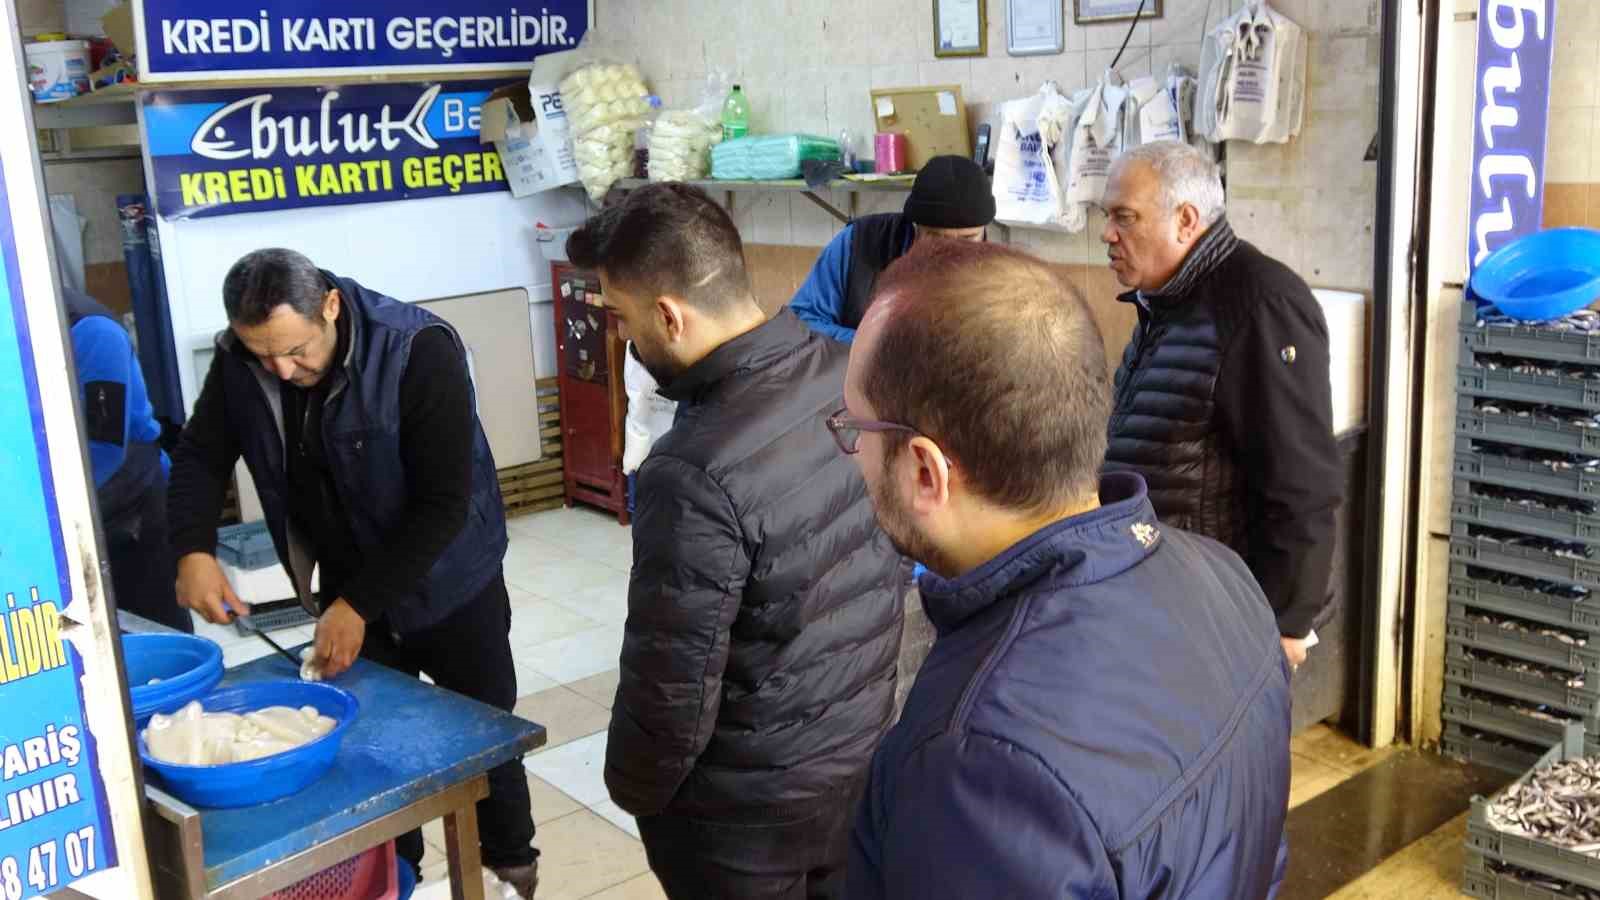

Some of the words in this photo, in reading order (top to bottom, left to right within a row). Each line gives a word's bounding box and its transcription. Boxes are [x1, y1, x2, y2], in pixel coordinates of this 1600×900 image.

[162, 10, 271, 54] KREDİ
[282, 18, 376, 51] KARTI
[386, 8, 576, 57] GEÇERLİDİR.
[251, 90, 401, 159] bulut
[444, 98, 481, 132] Ba
[540, 91, 565, 112] PE
[1475, 0, 1546, 267] bulu
[295, 160, 393, 197] KARTI
[402, 152, 504, 192] GEÇER
[0, 586, 66, 684] LİDİR
[0, 724, 81, 778] ARİŞ
[0, 856, 22, 900] 8
[28, 839, 58, 892] 47
[64, 825, 96, 877] 07
